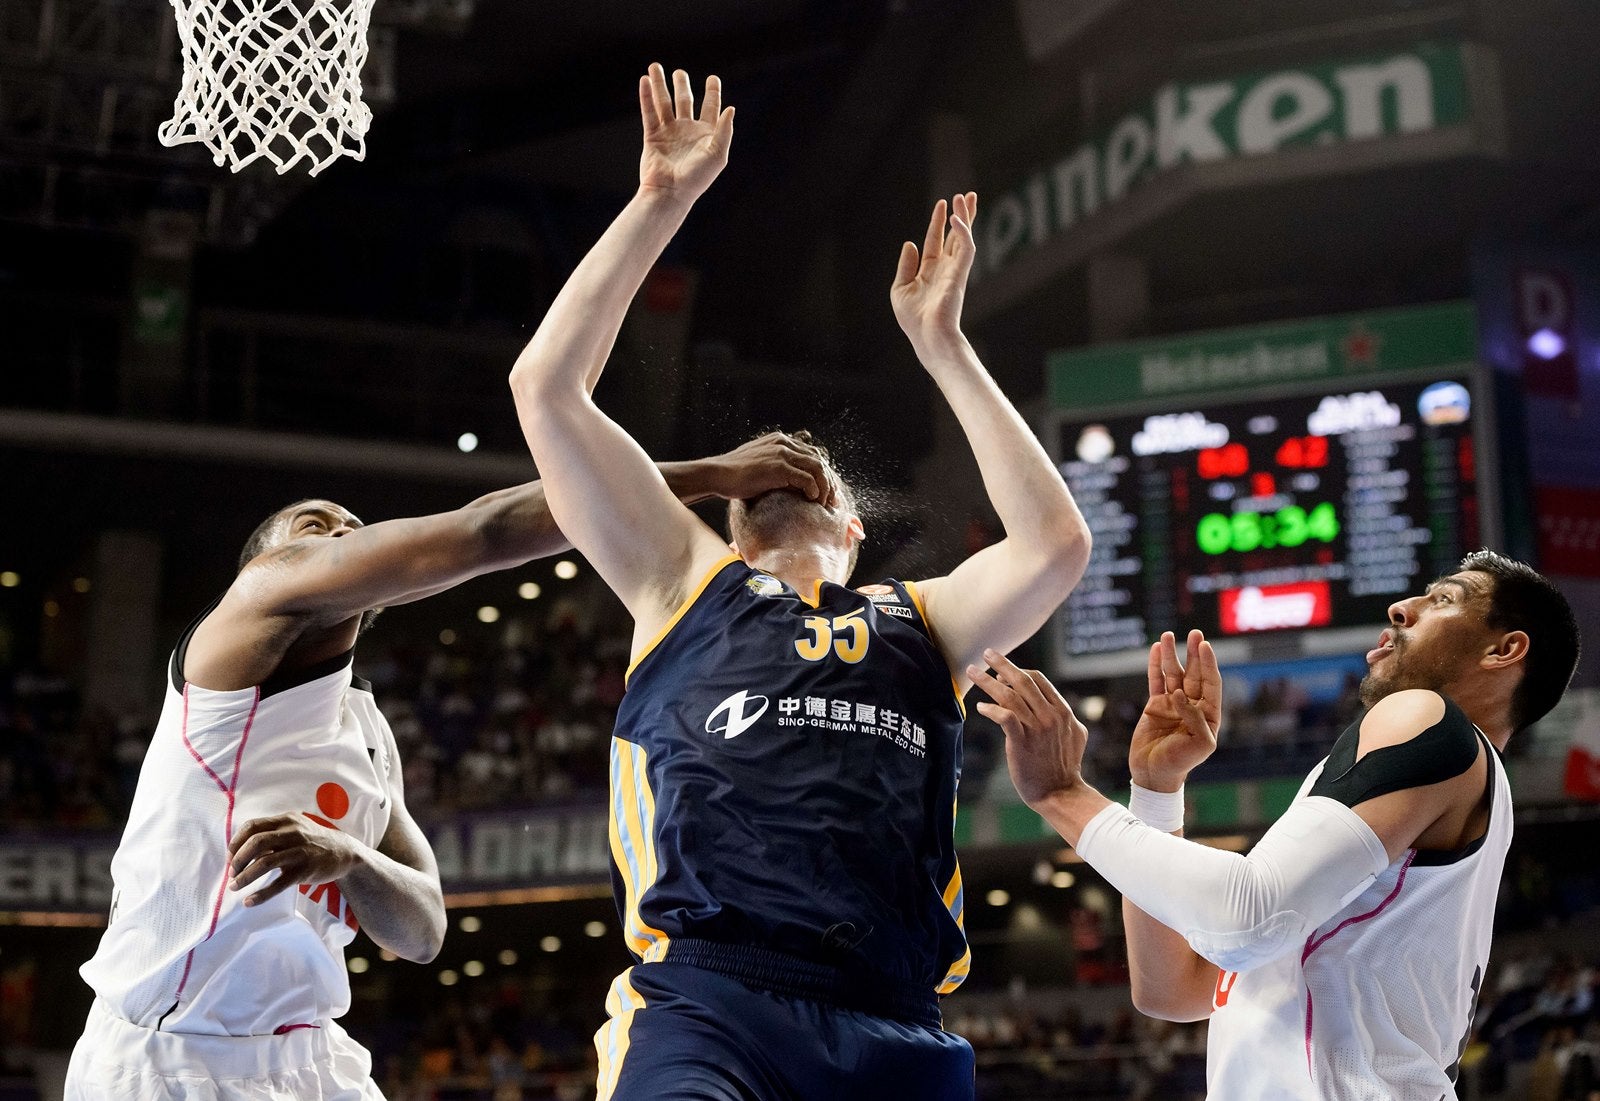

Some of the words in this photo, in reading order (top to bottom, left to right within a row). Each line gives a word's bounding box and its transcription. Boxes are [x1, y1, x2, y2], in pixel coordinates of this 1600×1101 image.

[972, 55, 1434, 276] eineken
[1196, 502, 1341, 556] 05:34
[794, 607, 870, 664] 35
[777, 717, 857, 733] SINO-GERMAN
[861, 724, 893, 741] METAL
[894, 734, 909, 749] ECO
[909, 744, 926, 759] CITY
[778, 695, 927, 749] 中德金属生态城
